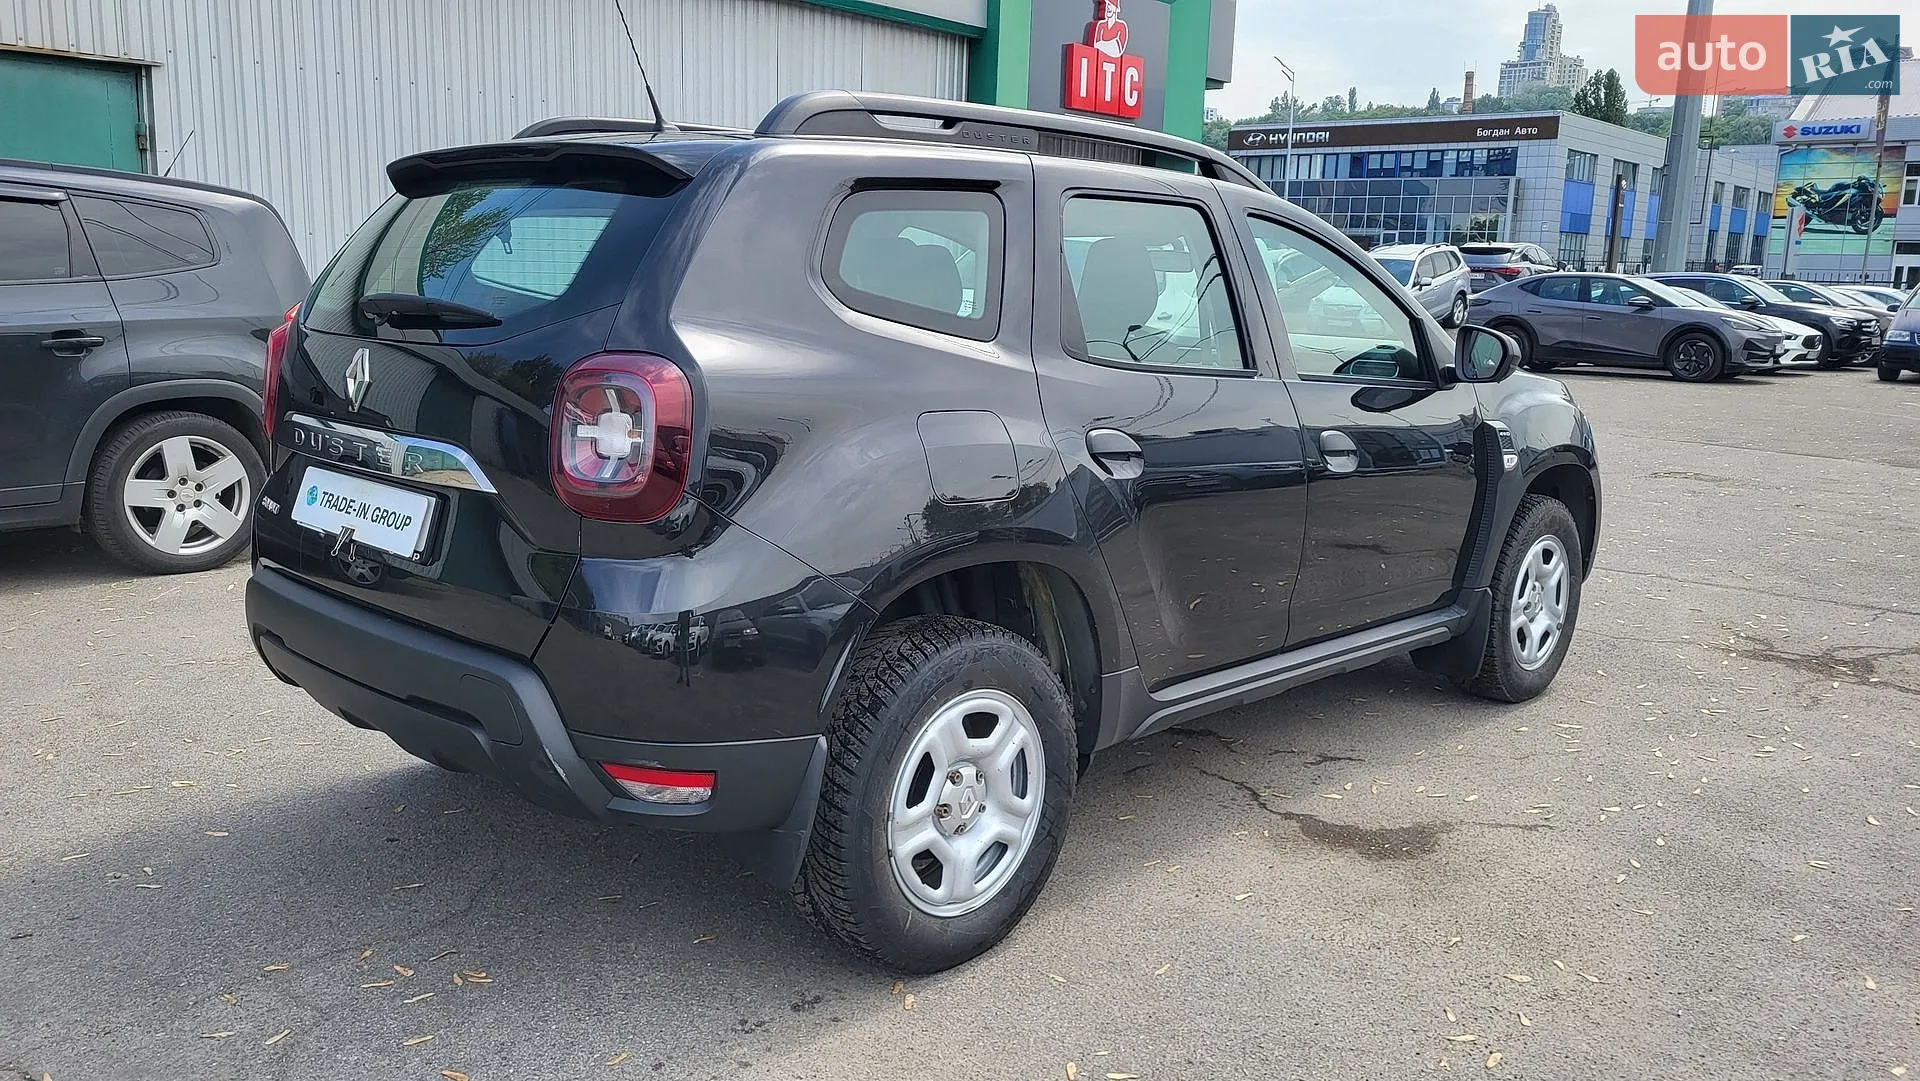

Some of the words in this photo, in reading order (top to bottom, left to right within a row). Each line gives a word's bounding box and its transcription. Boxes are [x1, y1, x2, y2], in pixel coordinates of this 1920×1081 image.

[1079, 57, 1139, 107] ITC
[962, 130, 1031, 144] DUSTER
[1476, 127, 1510, 137] Богдан
[1514, 126, 1538, 136] Авто
[1800, 124, 1862, 136] SUZUKI
[1269, 131, 1330, 145] HYUNDAI
[294, 427, 424, 473] DUSTER
